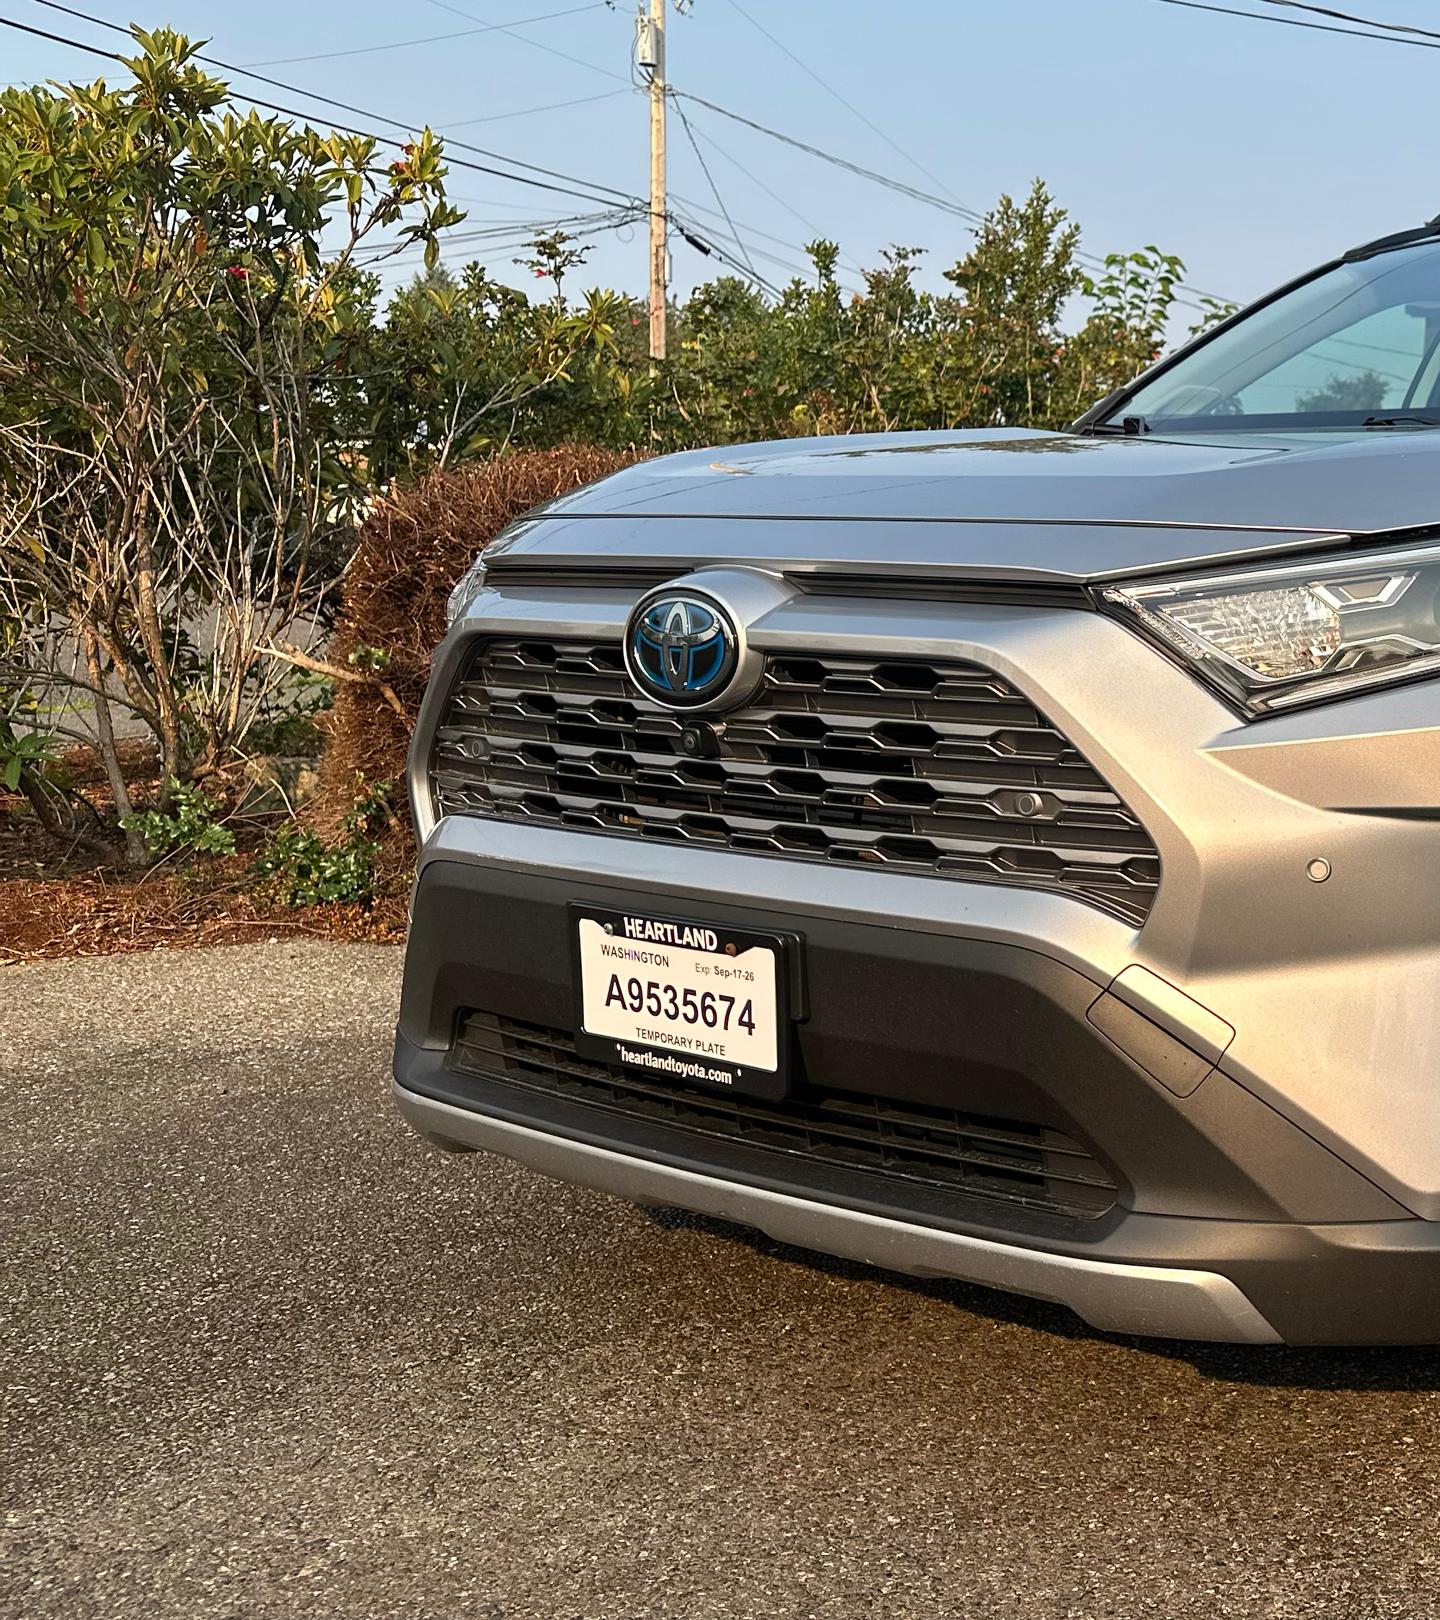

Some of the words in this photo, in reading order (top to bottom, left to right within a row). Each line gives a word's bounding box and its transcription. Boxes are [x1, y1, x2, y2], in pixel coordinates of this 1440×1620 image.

[623, 916, 718, 951] HEARTLAND
[600, 944, 670, 967] WASHINGTON
[714, 965, 755, 982] Sep-17-26
[604, 973, 756, 1036] A9535674
[635, 1027, 693, 1050] TEMPORARY
[695, 1039, 726, 1056] PLATE
[621, 1046, 733, 1085] heartlandtoyota.com
